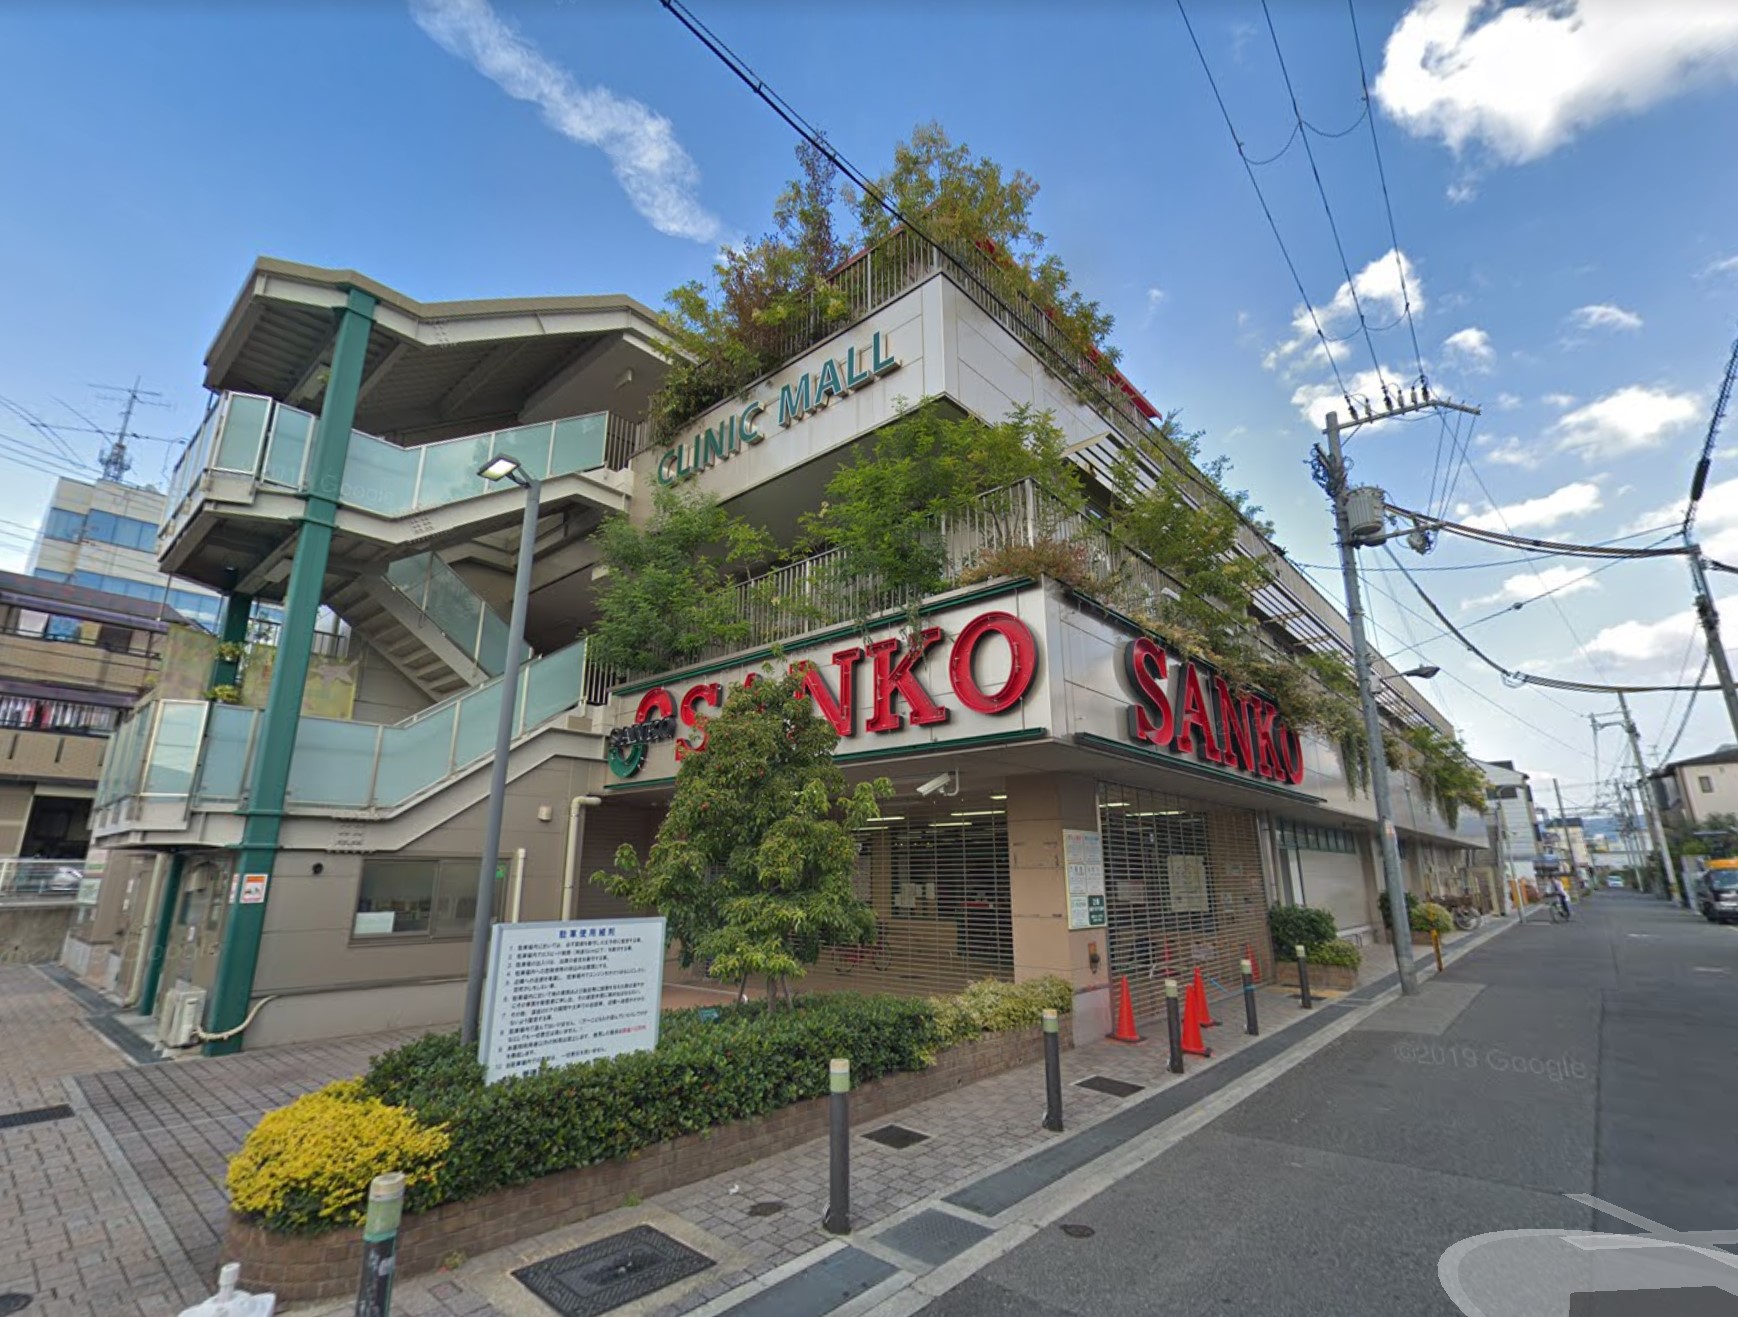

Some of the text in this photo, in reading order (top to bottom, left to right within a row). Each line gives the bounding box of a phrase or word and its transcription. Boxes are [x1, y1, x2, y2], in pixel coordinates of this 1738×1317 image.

[657, 331, 902, 488] CLINIC MALL
[675, 610, 1038, 762] SNKO
[1125, 636, 1305, 786] SANKO
